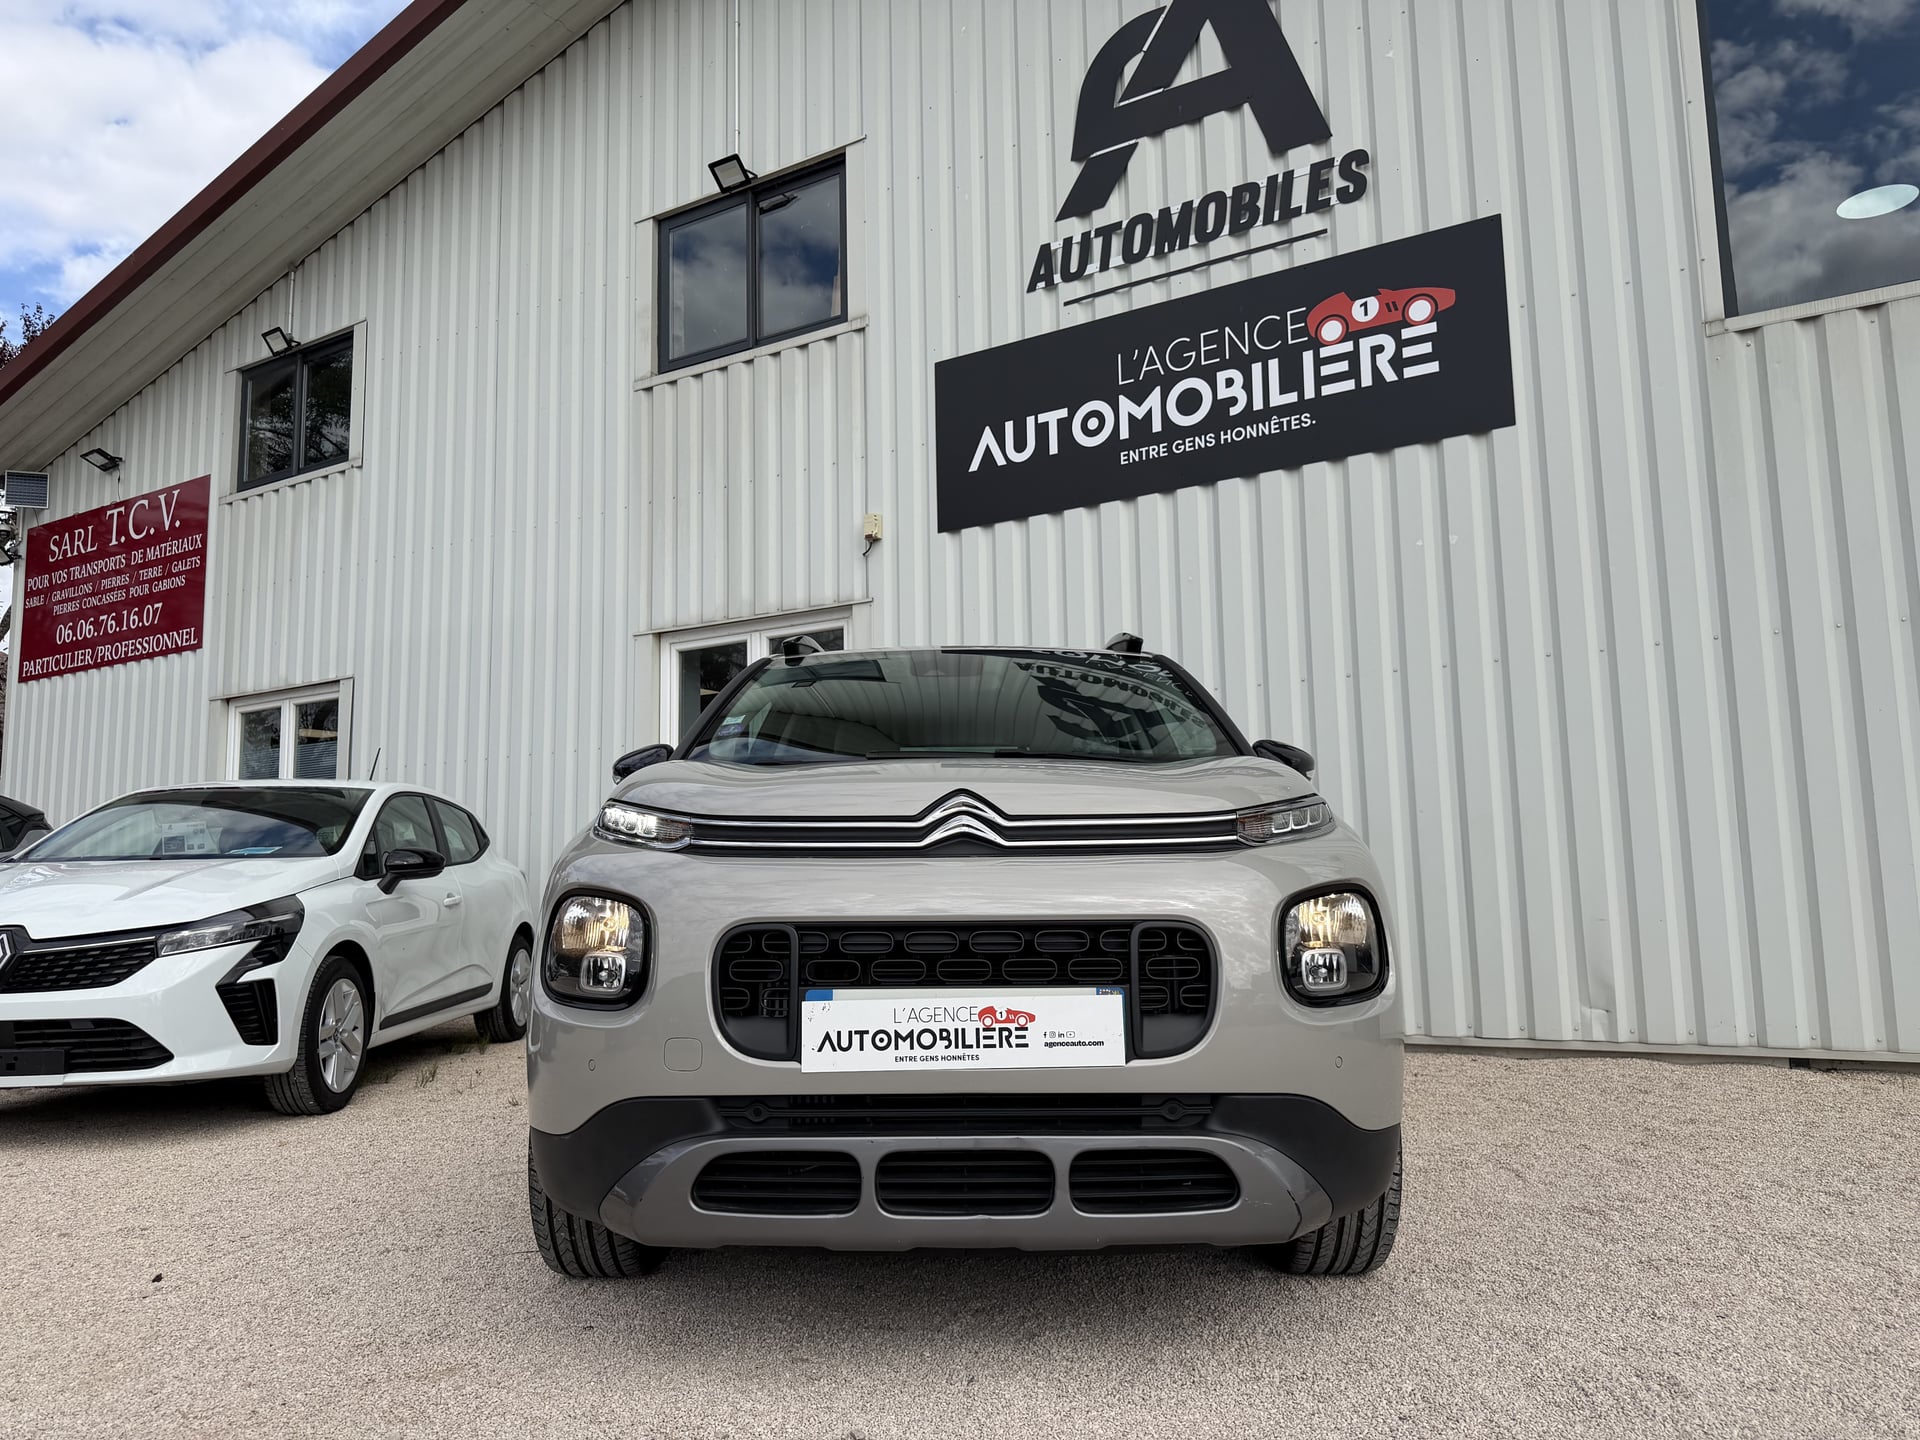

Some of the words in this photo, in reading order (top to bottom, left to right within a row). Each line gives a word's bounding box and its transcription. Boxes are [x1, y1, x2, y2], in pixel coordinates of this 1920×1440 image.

[1026, 149, 1370, 293] AUTOMOBILES
[1116, 307, 1309, 386] L'AGENCE
[968, 321, 1440, 472] AUTOMOBILIERE
[1119, 444, 1168, 465] ENTRE
[1172, 435, 1216, 454] GENS
[1220, 413, 1316, 444] HONNÊTES.
[49, 525, 98, 562] SARL
[106, 489, 181, 547] T.C.V.
[25, 595, 45, 609] SABLE
[51, 582, 93, 603] GRAVILLONS
[101, 574, 130, 590] PIERRES
[139, 565, 163, 581] TERRE
[171, 556, 201, 573] GALETS
[27, 575, 49, 592] POUR
[51, 569, 67, 585] VOS
[69, 554, 126, 581] TRANSPORTS
[131, 550, 144, 565] DE
[145, 534, 203, 562] MATÉRIAUX
[53, 600, 80, 616] PIERRES
[82, 587, 126, 609] CONCASSÉES
[129, 583, 150, 598] POUR
[152, 574, 186, 592] GABIONS
[56, 602, 163, 645] 06.06.76.16.07
[22, 627, 198, 677] PARTICULIER/PROFESSIONNEL
[817, 1027, 1029, 1052] AUTOMOBILIERE
[893, 1005, 978, 1023] L'AGENCE
[941, 1053, 980, 1061] HONNÊTES
